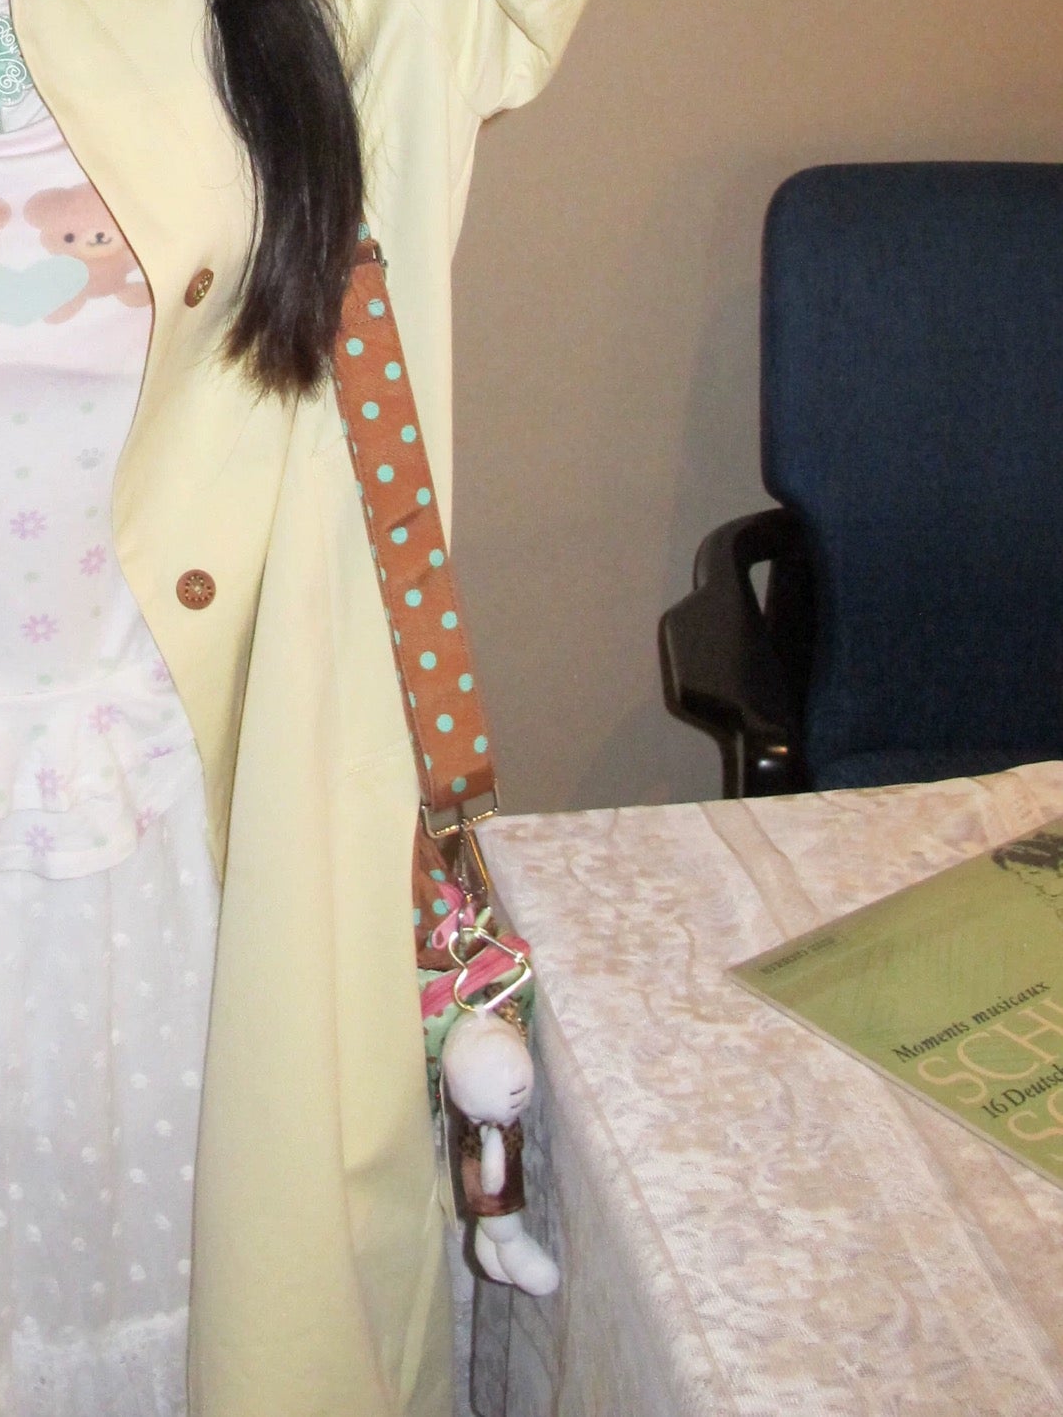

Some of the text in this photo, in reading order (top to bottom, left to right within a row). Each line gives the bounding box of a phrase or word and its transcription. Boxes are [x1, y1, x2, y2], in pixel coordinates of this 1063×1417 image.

[891, 982, 1050, 1063] Moments musicaux
[917, 998, 1063, 1104] SCH
[983, 1097, 1009, 1119] 16
